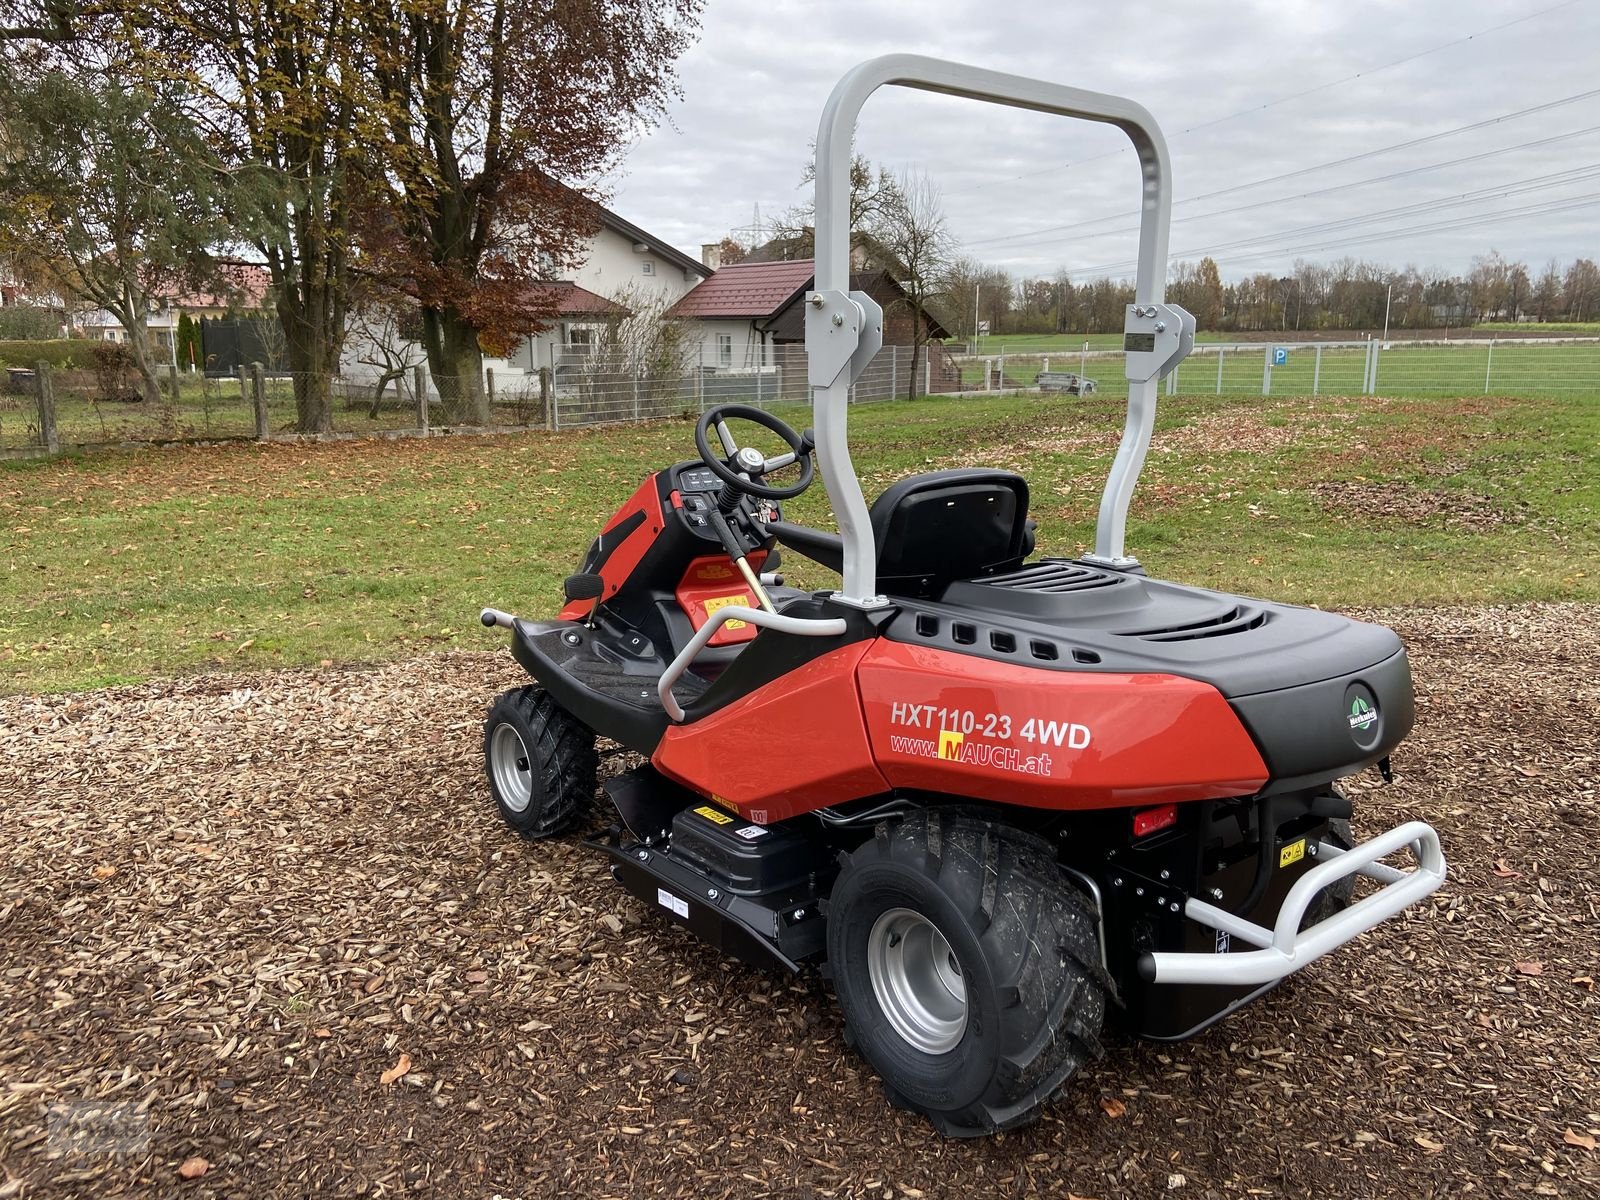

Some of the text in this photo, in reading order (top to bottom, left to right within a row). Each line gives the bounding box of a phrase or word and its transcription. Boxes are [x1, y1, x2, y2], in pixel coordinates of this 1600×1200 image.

[1276, 349, 1285, 364] P
[891, 702, 1091, 750] HXT110-23 4WD
[890, 735, 1053, 776] www.MAUCH.at
